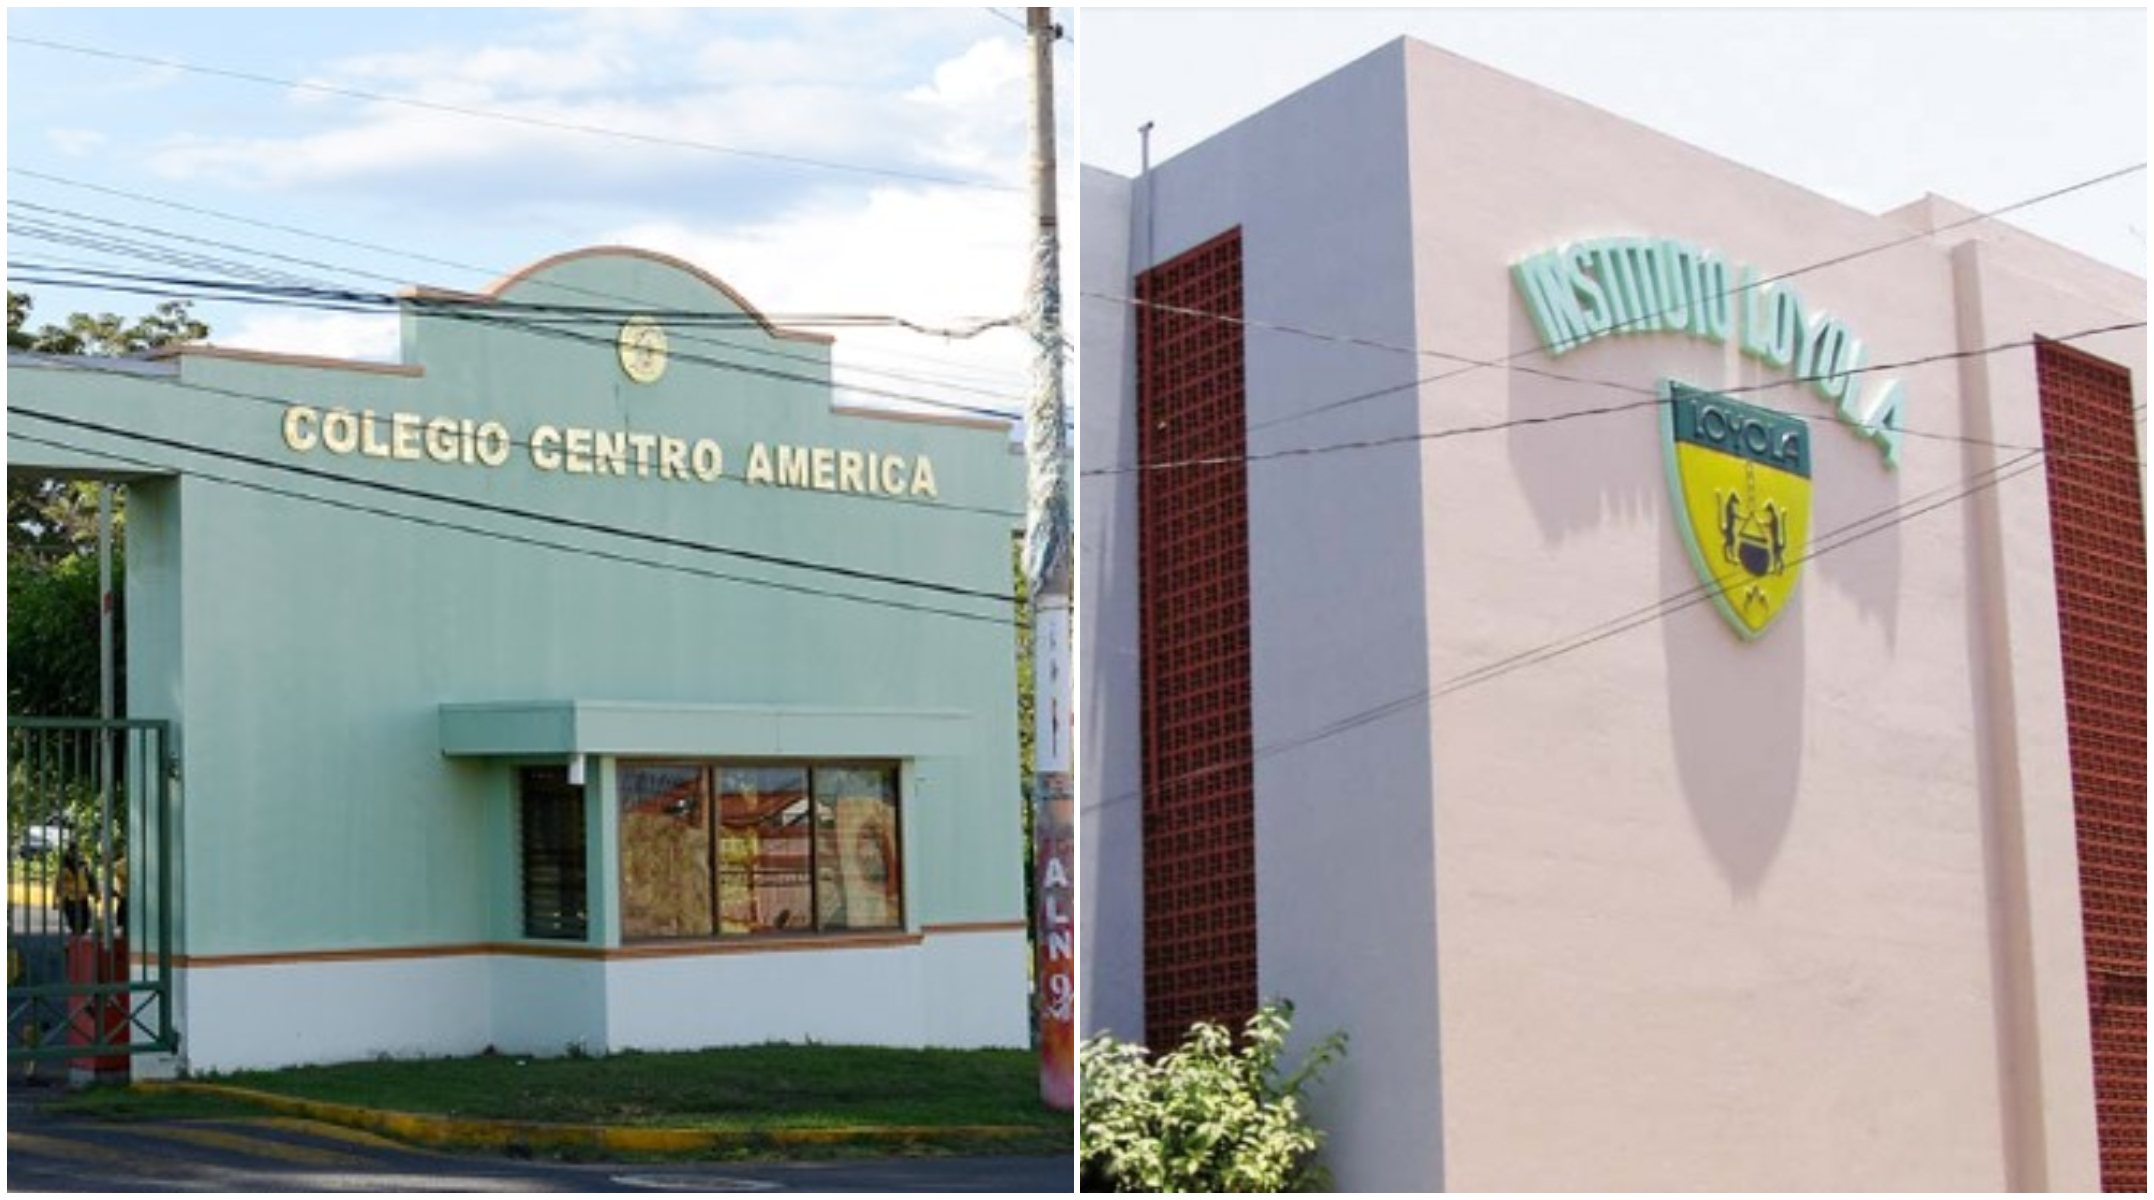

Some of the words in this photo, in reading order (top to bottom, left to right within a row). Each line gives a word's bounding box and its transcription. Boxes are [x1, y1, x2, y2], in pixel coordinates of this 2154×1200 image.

[1508, 236, 1730, 358] INSTITUTO
[1739, 262, 1906, 471] LOYOLA
[283, 404, 510, 466] COLEGIO
[530, 424, 723, 483] CENTRO
[745, 442, 939, 498] AMERICA
[1691, 399, 1800, 462] LOYOLA
